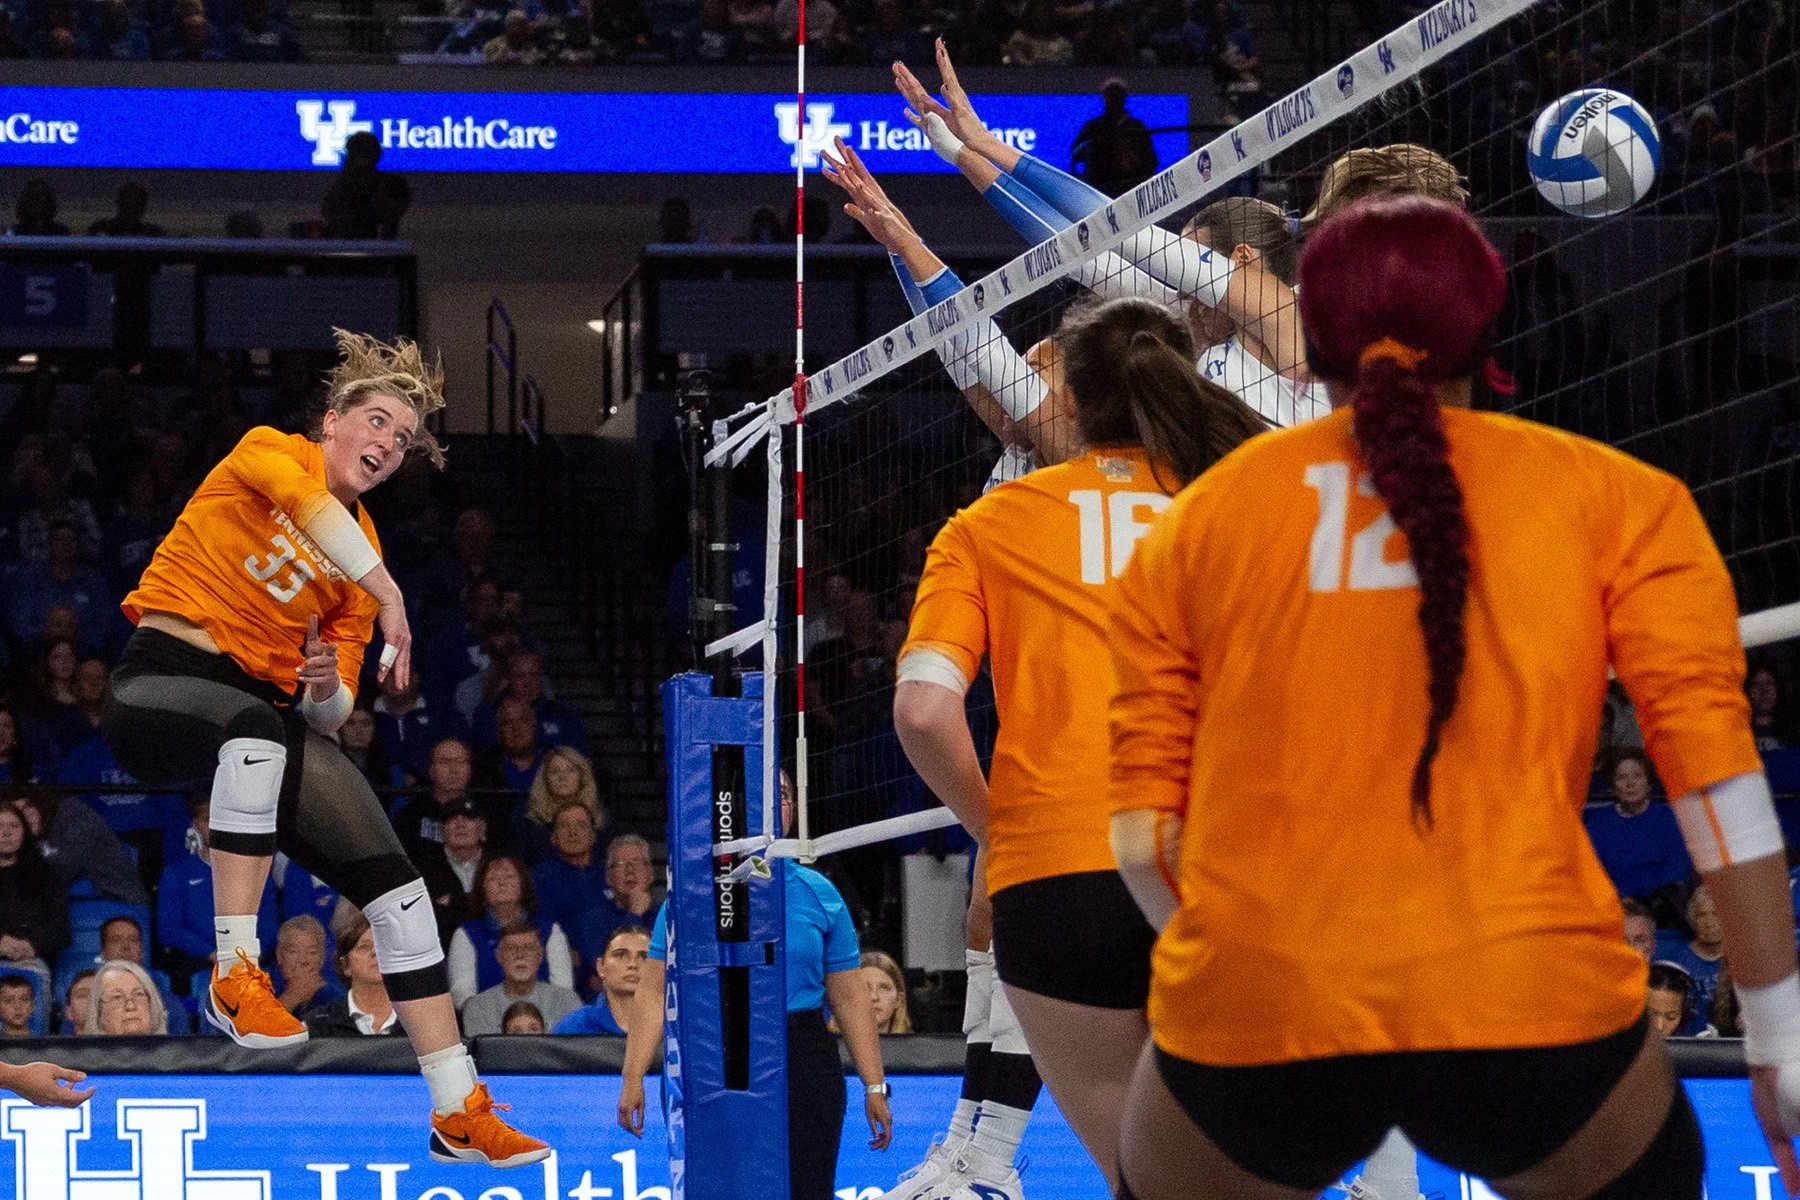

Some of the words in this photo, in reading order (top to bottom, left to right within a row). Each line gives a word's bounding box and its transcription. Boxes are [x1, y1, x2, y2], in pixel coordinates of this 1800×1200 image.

[381, 116, 558, 150] HealthCare
[859, 120, 1036, 151] Heaare
[1565, 93, 1618, 140] molten
[1024, 238, 1062, 282] WILDCATS
[1136, 170, 1179, 219] WILDCATS
[1265, 87, 1315, 142] WILDCATS
[1418, 0, 1477, 51] WILDCATS
[25, 276, 56, 316] 5
[715, 791, 734, 846] sport
